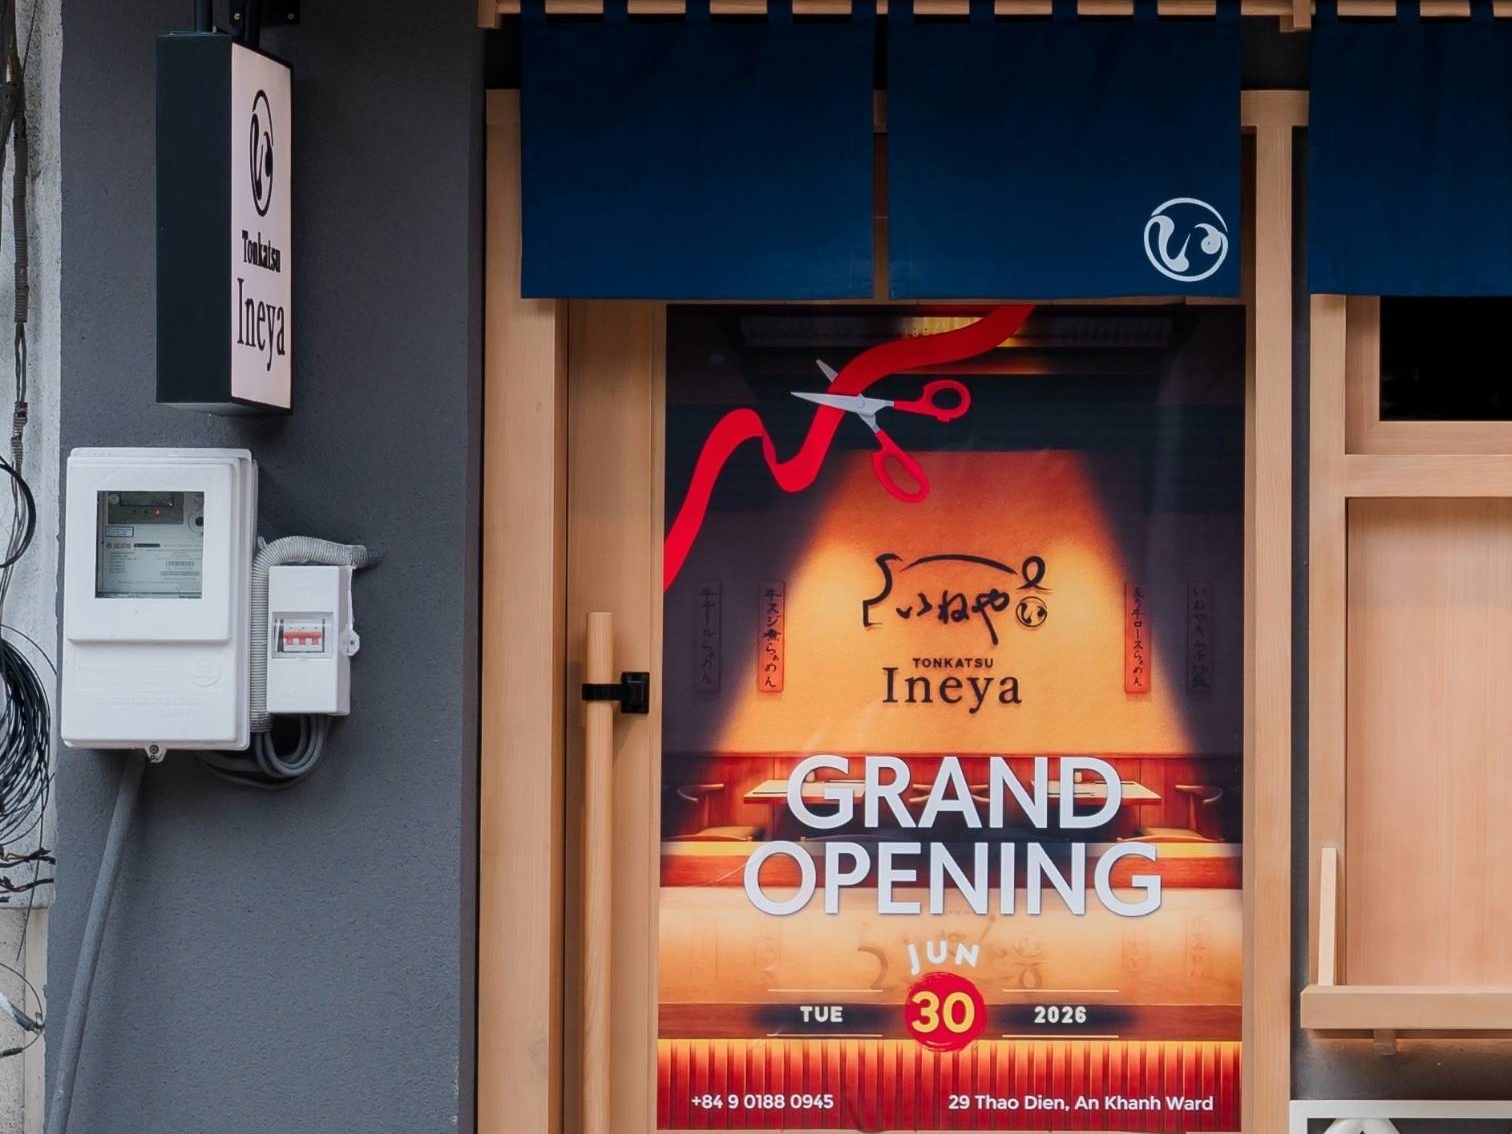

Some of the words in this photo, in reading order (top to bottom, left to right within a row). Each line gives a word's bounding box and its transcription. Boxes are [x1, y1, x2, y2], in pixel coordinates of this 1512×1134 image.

[241, 229, 281, 273] Tonkatsu
[237, 277, 286, 372] Ineya
[912, 657, 994, 669] TONKATSU
[882, 666, 1022, 714] Ineya
[787, 754, 1123, 830] GRAND
[743, 841, 1163, 917] OPENING
[908, 939, 981, 975] JUN
[800, 1006, 844, 1023] TUE
[911, 991, 975, 1034] 30
[1034, 1006, 1087, 1024] 2026
[691, 1094, 723, 1110] +84
[728, 1094, 738, 1110] 9
[743, 1094, 785, 1110] 0188
[790, 1094, 834, 1110] 0945
[948, 1095, 970, 1110] 29
[975, 1095, 1020, 1110] Thao
[1025, 1095, 1070, 1113] Dien,
[1074, 1095, 1099, 1110] An
[1105, 1095, 1161, 1110] Khanh
[1165, 1096, 1214, 1111] Ward
